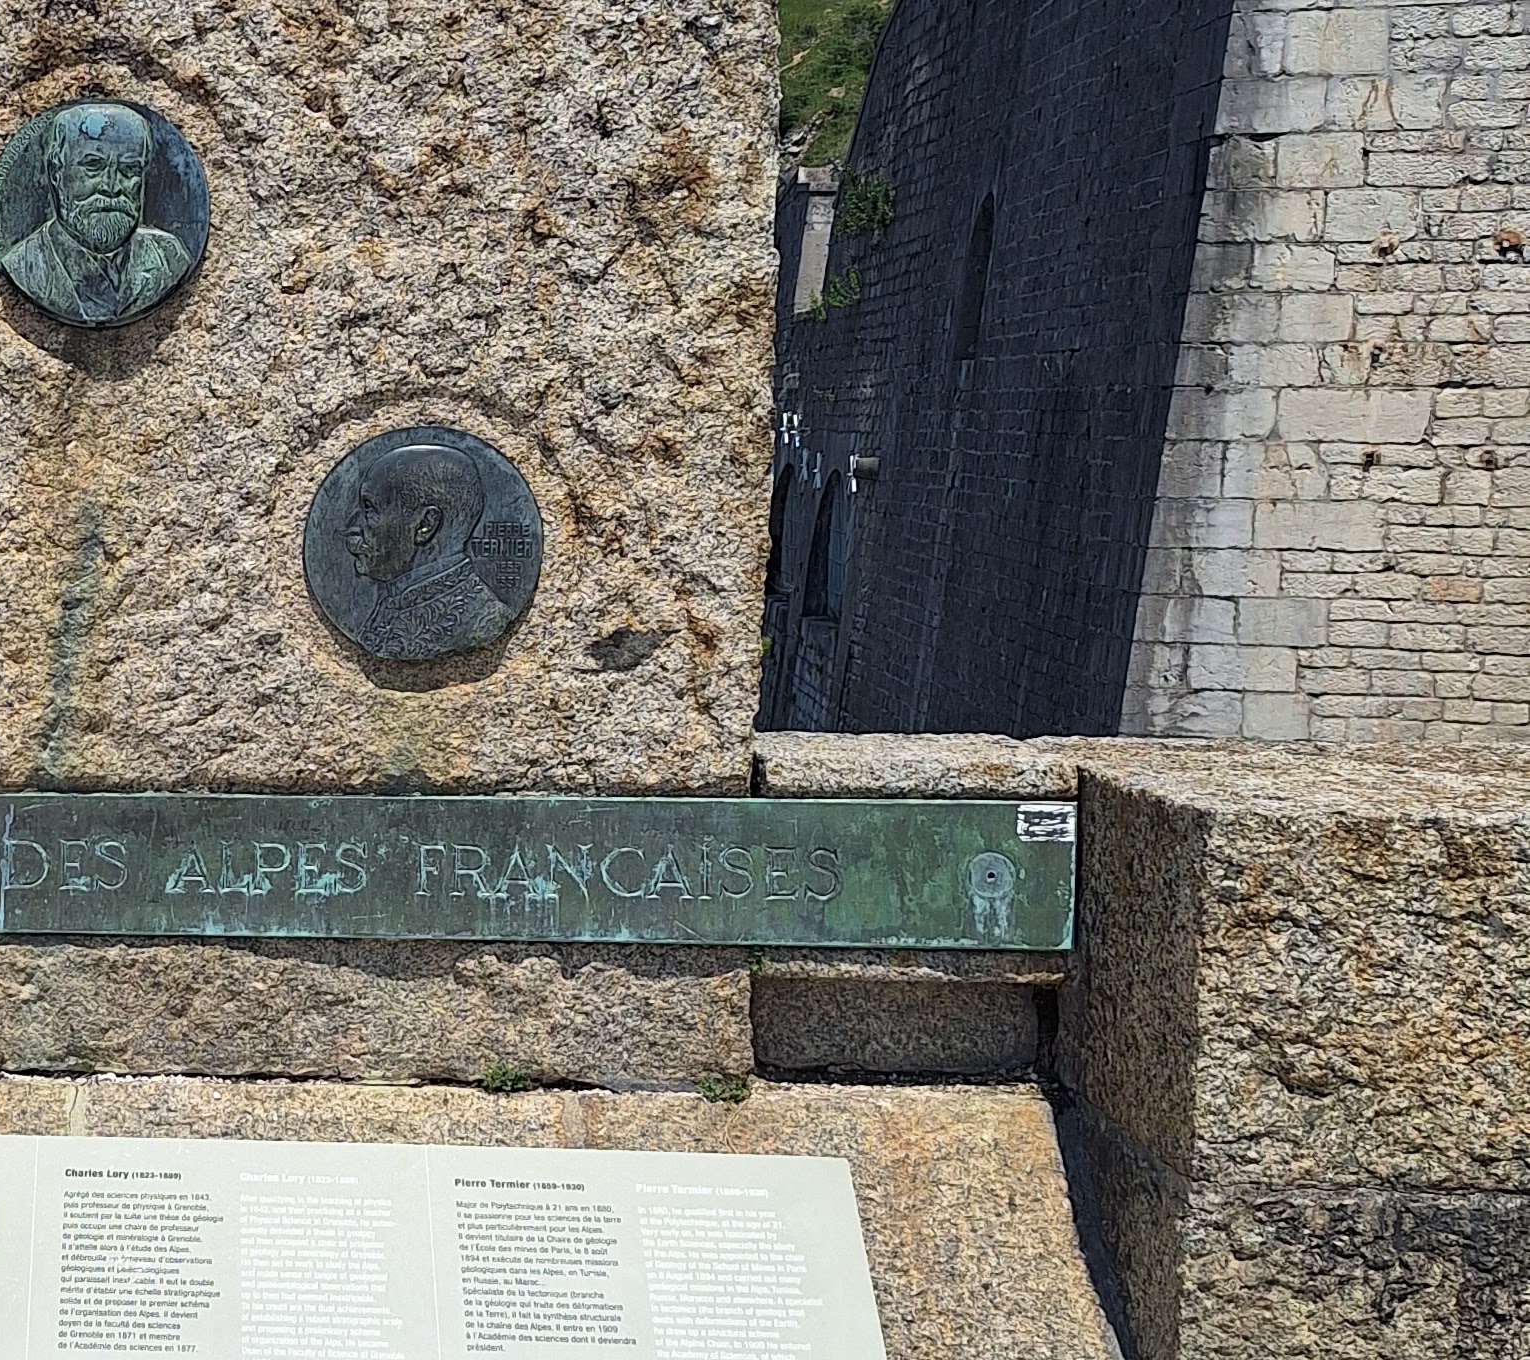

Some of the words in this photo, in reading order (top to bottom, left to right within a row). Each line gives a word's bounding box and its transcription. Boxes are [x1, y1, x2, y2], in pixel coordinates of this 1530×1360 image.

[484, 522, 531, 537] PIERRE
[471, 538, 533, 558] TERMIER
[0, 837, 129, 893] DES
[164, 838, 372, 896] ALPES
[64, 1168, 104, 1178] Charles
[106, 1169, 129, 1180] Lory
[239, 1171, 279, 1182] Charles
[281, 1172, 305, 1185] Lory
[454, 1178, 487, 1188] Pierre
[489, 1178, 530, 1189] Termier
[635, 1183, 668, 1194] Pierre
[670, 1184, 713, 1195] Termier
[57, 1329, 68, 1338] de
[69, 1329, 104, 1339] Grenoble
[118, 1331, 136, 1340] 1871
[138, 1332, 147, 1340] et
[148, 1333, 180, 1341] membre
